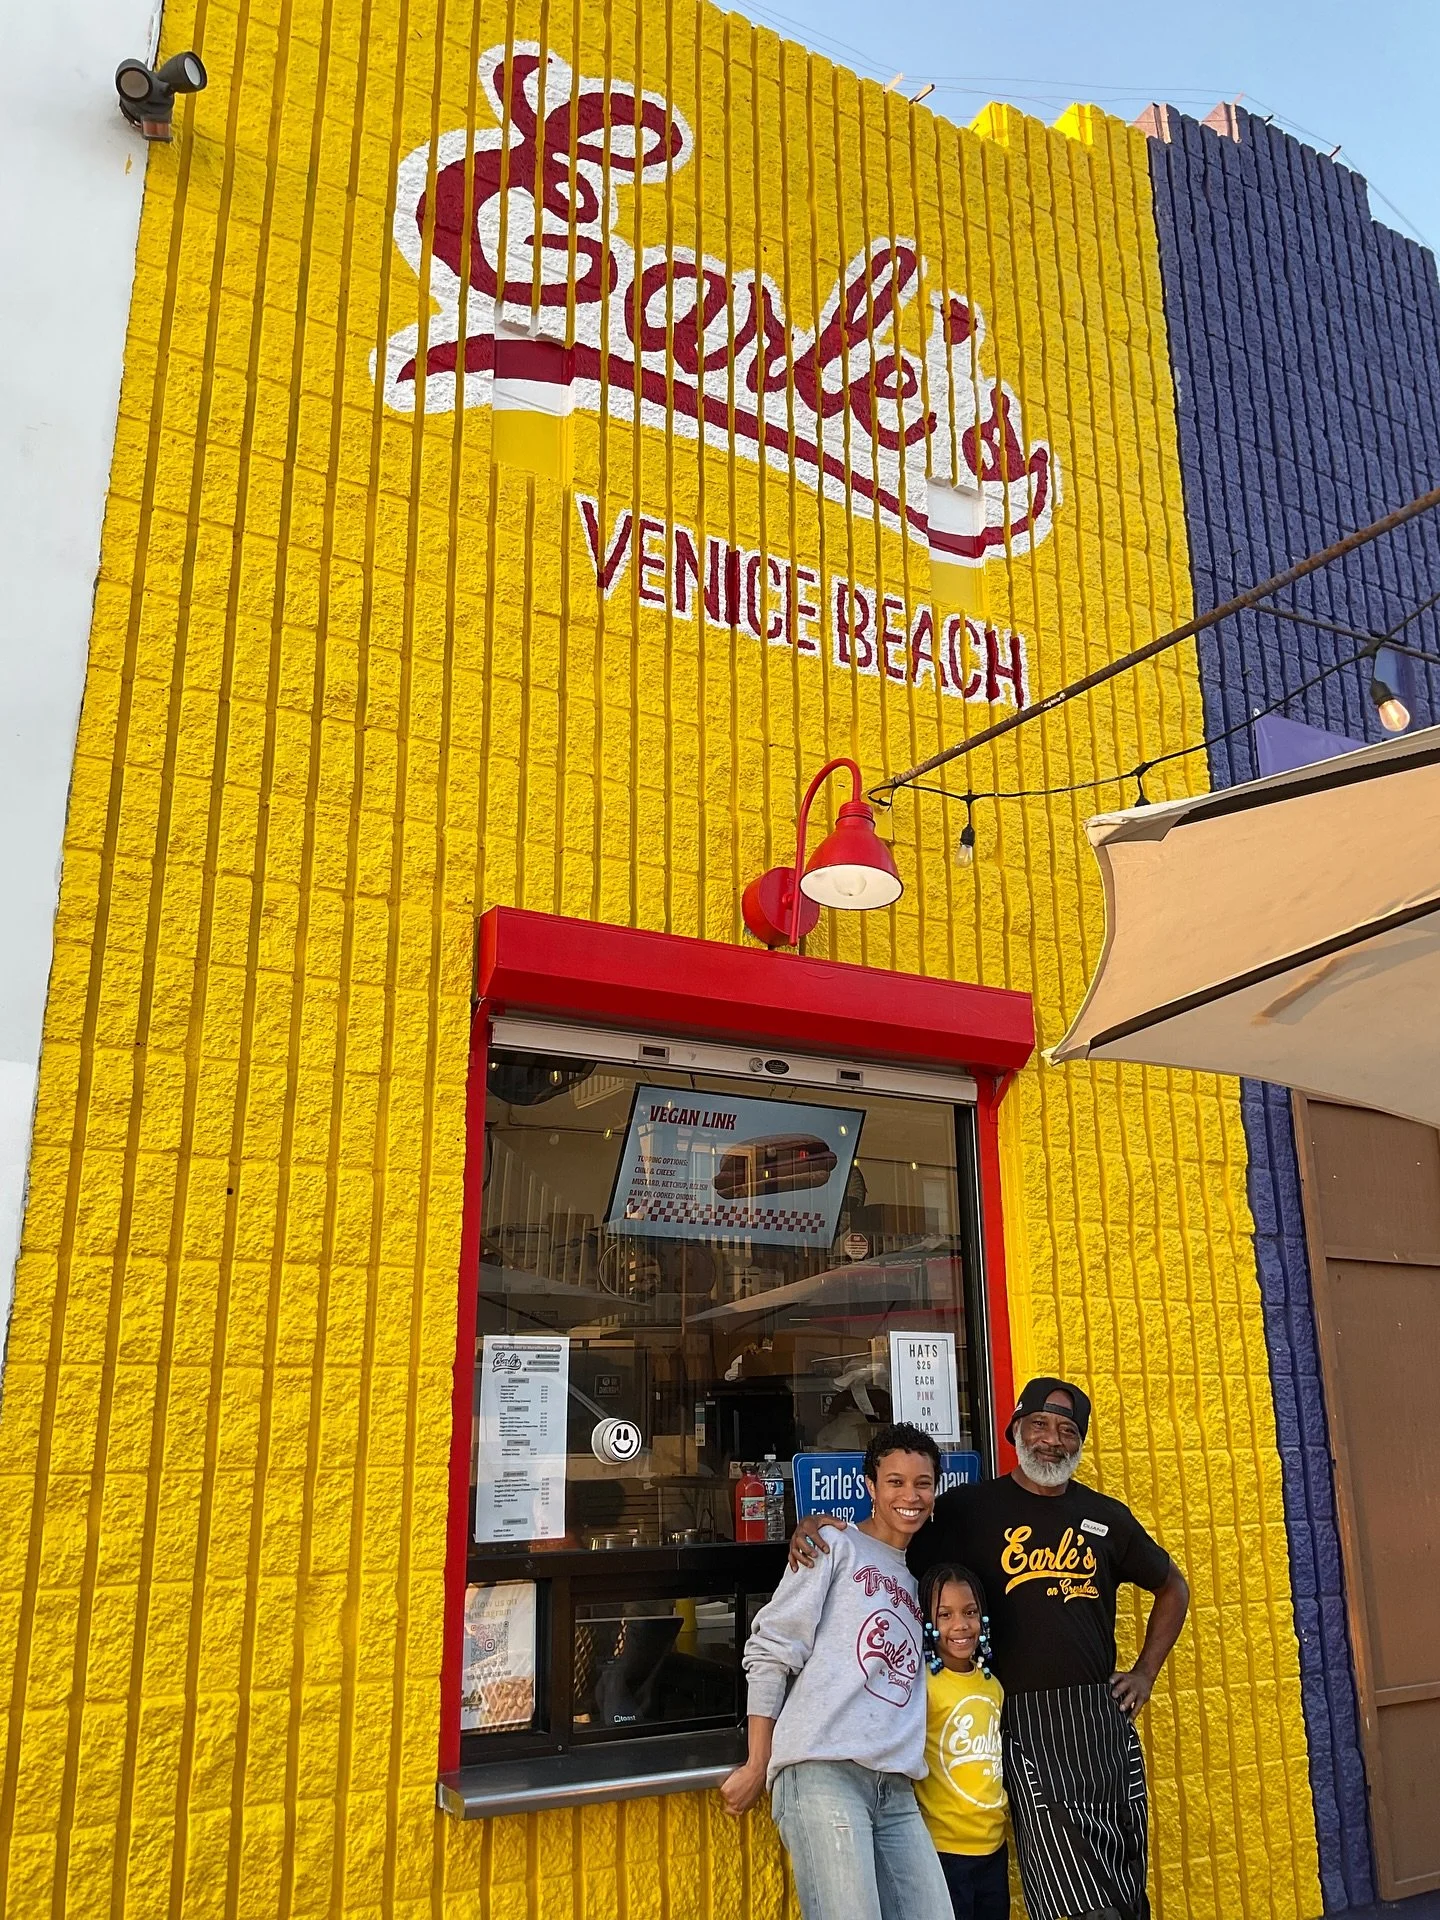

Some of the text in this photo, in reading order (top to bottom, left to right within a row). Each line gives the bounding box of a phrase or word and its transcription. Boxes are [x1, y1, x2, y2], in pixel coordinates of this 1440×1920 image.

[400, 52, 1052, 560] Earle's
[579, 498, 1026, 708] VENICE BEACH
[649, 1104, 738, 1130] VEGAN LINK
[656, 1168, 676, 1176] CHEESE
[652, 1191, 675, 1199] COOKED
[909, 1344, 938, 1358] HATS
[916, 1360, 931, 1370] $25
[914, 1376, 935, 1386] EACH
[916, 1391, 935, 1401] PINK
[921, 1406, 931, 1416] OR
[811, 1467, 865, 1500] Earle's
[831, 1507, 855, 1524] 1992
[1082, 1522, 1106, 1534] DUANE
[1001, 1525, 1097, 1594] Earle's
[1046, 1587, 1059, 1596] on
[863, 1616, 917, 1679] Earle's
